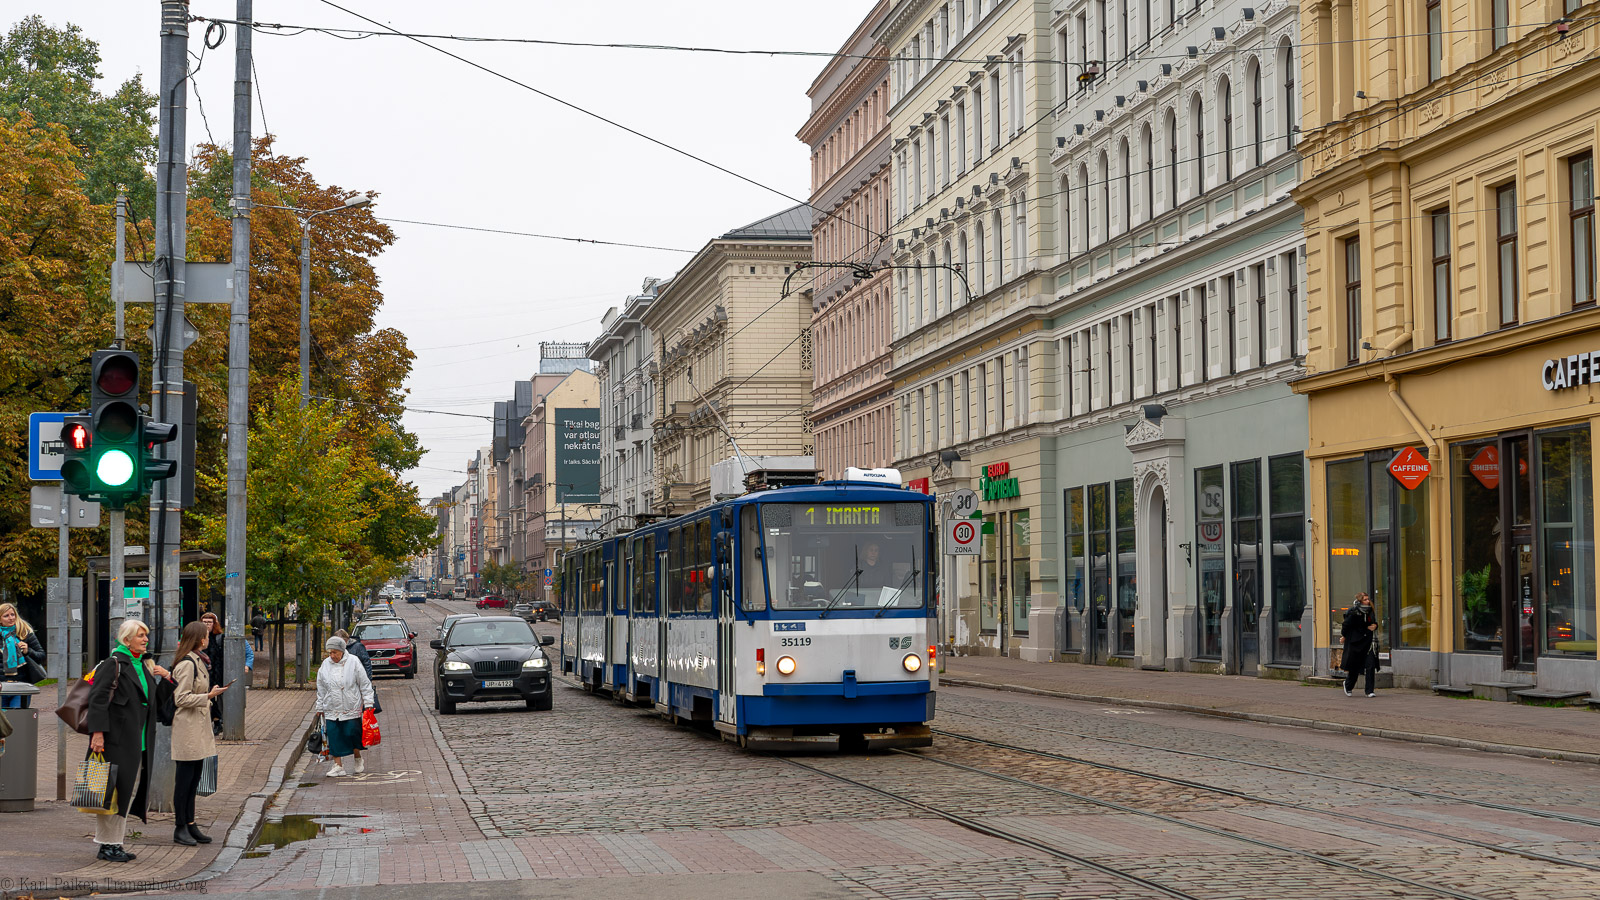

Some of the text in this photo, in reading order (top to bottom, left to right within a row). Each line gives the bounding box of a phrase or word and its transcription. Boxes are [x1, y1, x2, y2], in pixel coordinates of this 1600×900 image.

[1542, 350, 1600, 391] CAFFE
[564, 420, 583, 428] Tikai
[579, 430, 600, 441] atļau
[564, 442, 591, 450] nekrāt
[988, 462, 1008, 477] EURO
[1392, 464, 1429, 472] CAFFEINE
[988, 477, 1020, 500] APTIEKA
[957, 494, 971, 509] 30
[805, 507, 880, 525] 1 IMANTA
[958, 527, 970, 539] 30
[781, 637, 812, 647] 35119
